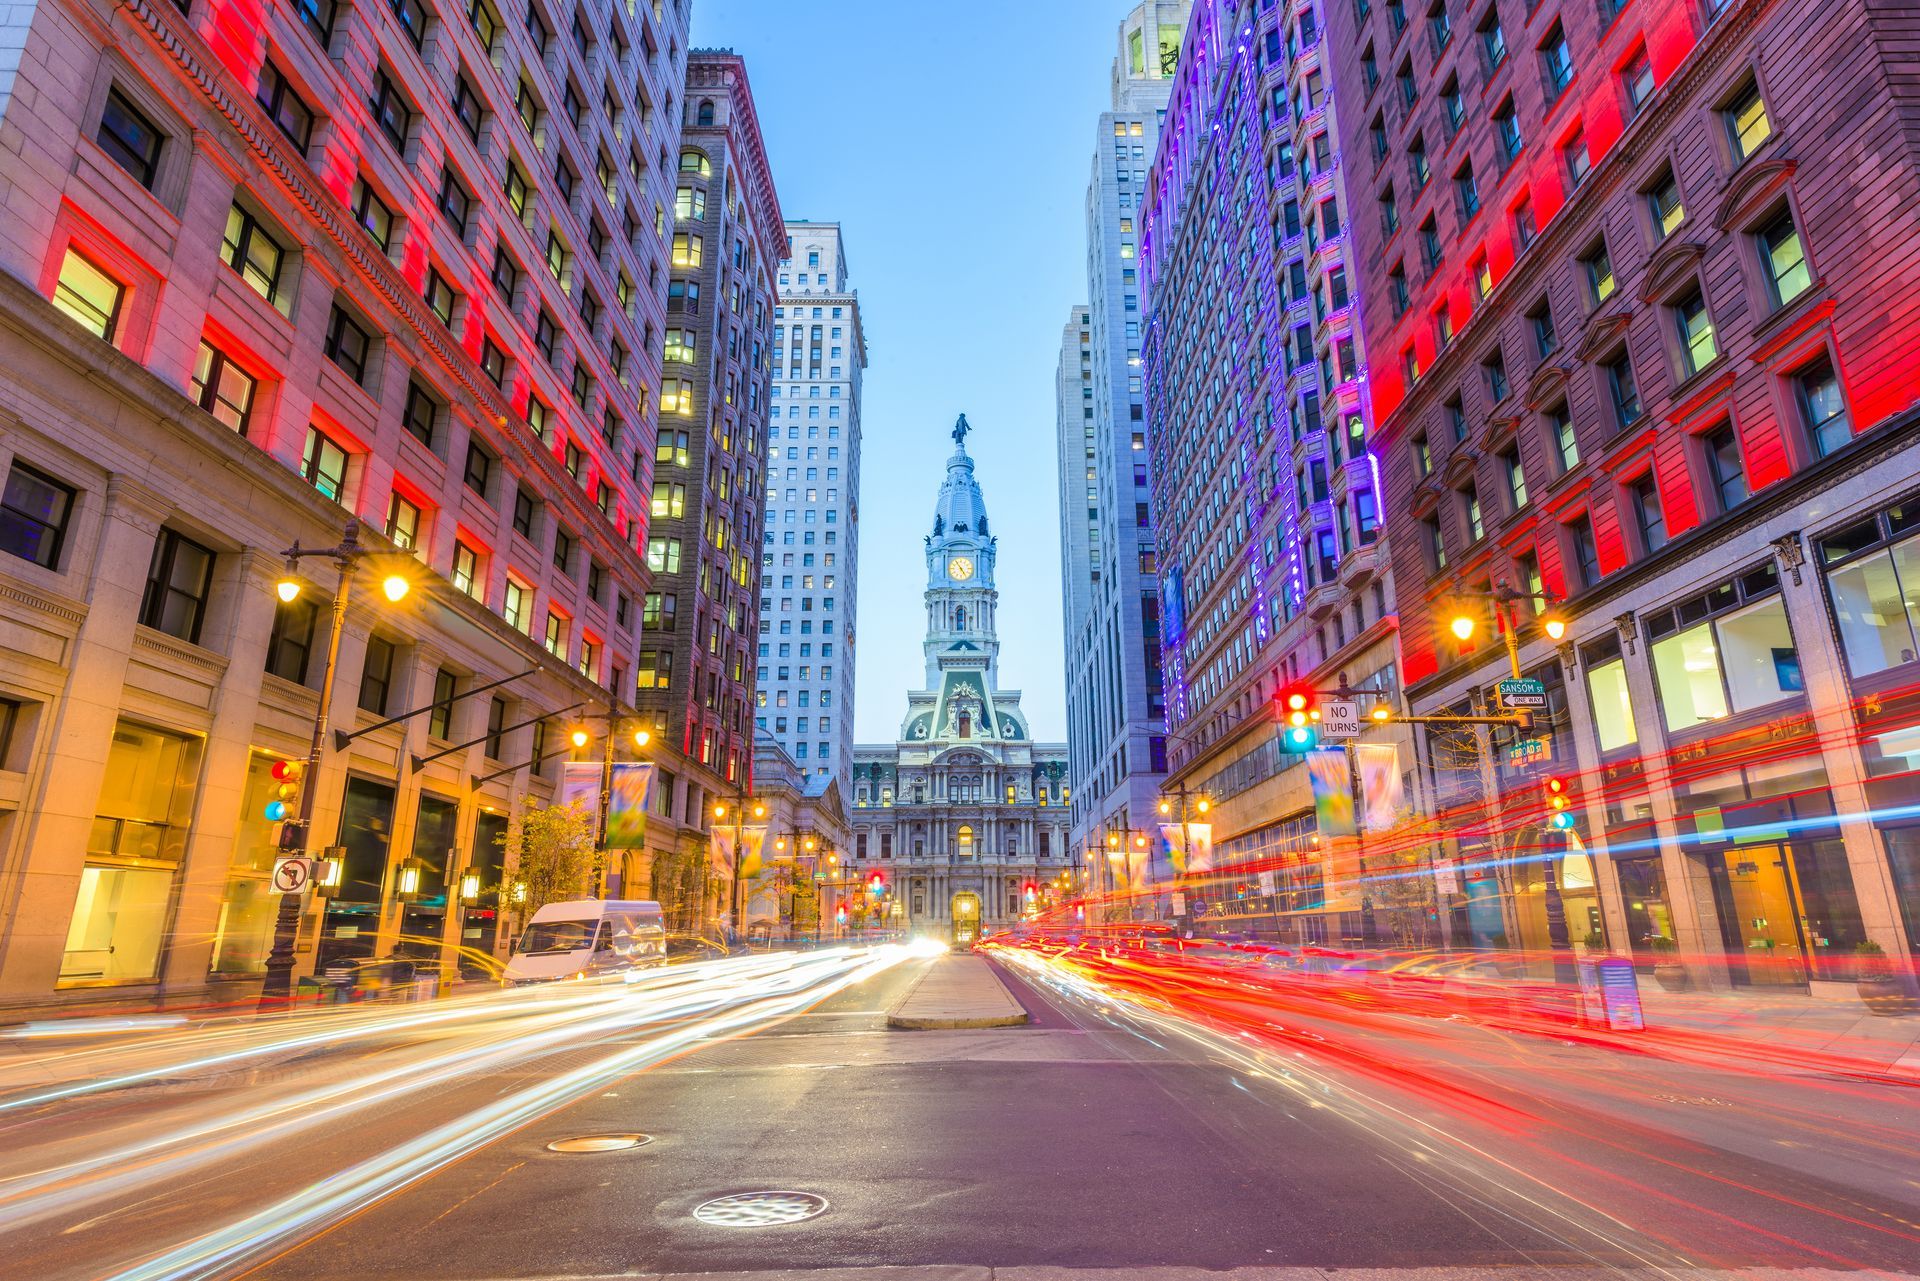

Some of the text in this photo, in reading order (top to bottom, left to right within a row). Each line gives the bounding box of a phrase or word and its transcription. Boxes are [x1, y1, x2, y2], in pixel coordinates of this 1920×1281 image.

[1500, 684, 1535, 693] SANSOM
[1331, 706, 1348, 718] NO
[1325, 723, 1358, 732] TURNS
[1514, 744, 1535, 759] BROAD
